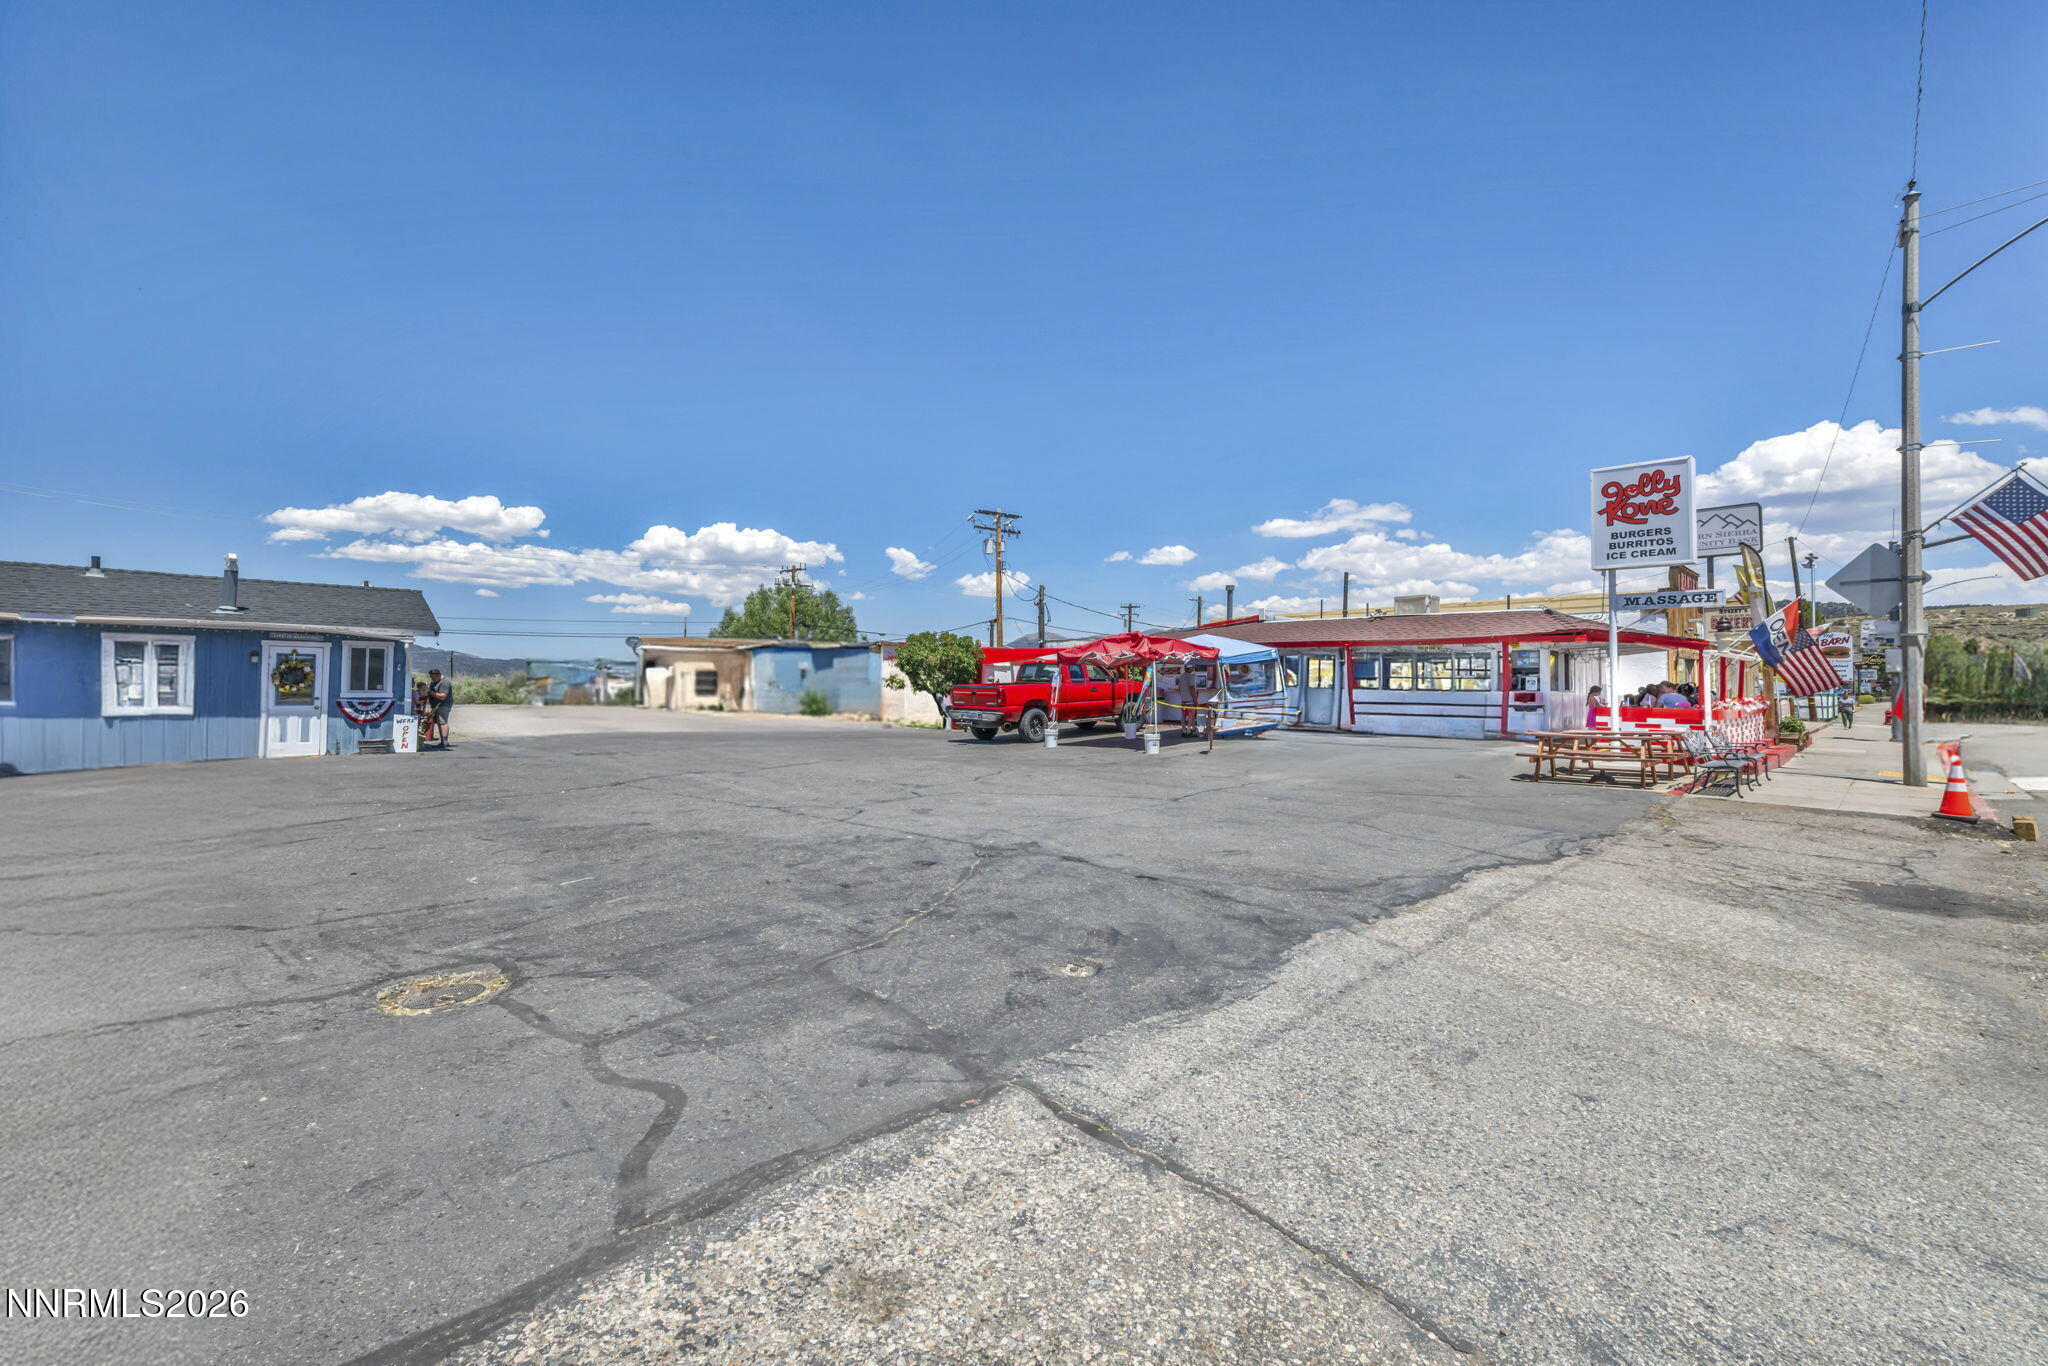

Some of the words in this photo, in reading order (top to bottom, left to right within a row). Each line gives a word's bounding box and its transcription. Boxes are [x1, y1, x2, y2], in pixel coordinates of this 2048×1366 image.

[1601, 469, 1681, 501] Jolly
[1597, 496, 1680, 526] Kone
[1611, 527, 1672, 540] BURGERS
[1716, 528, 1758, 538] SIERRA
[1609, 537, 1674, 550] BURRITOS
[1729, 536, 1758, 544] BANK
[1606, 552, 1627, 560] ICE
[1631, 547, 1677, 558] CREAM
[1623, 592, 1718, 607] MASSAGE
[1820, 635, 1850, 647] BARN
[401, 725, 409, 749] OPEN
